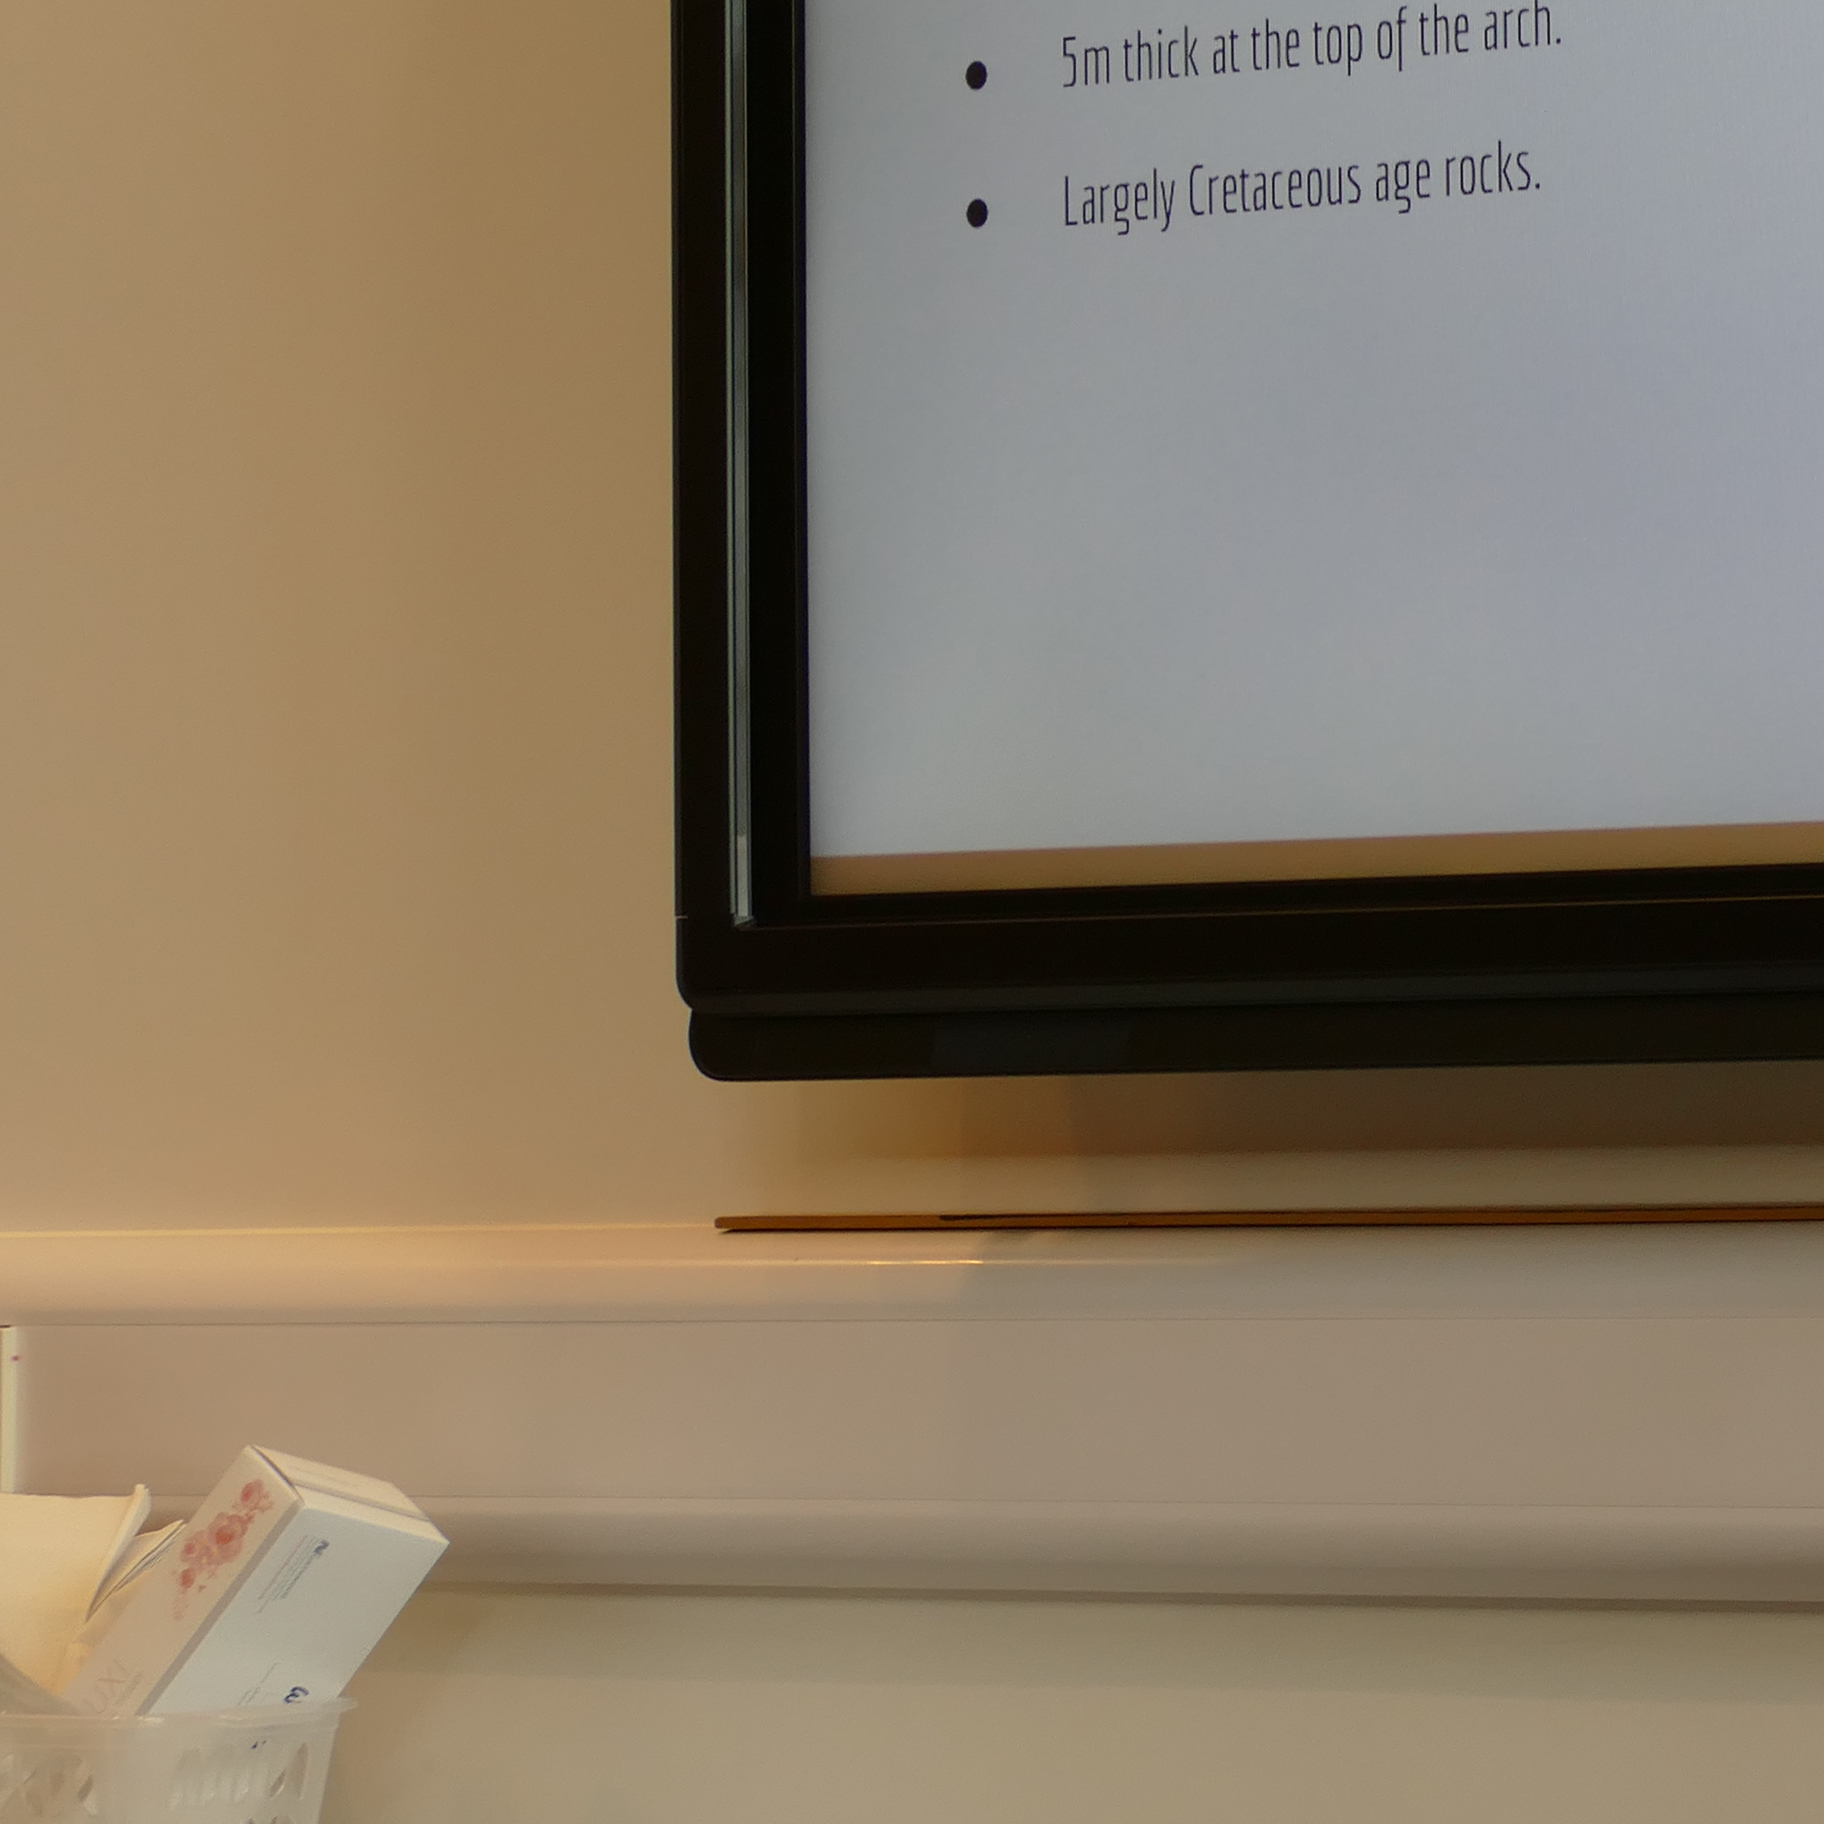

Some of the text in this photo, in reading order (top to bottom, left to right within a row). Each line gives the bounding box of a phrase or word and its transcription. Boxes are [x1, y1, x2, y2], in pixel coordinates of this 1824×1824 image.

[1062, 35, 1111, 89] 5m
[1122, 24, 1200, 83] thick
[1212, 28, 1241, 75] at
[1250, 17, 1301, 71] the
[1312, 21, 1364, 78] top
[1376, 5, 1408, 73] of
[1418, 2, 1470, 57] the
[1064, 139, 1541, 237] Largely Cretaceous age rocks.
